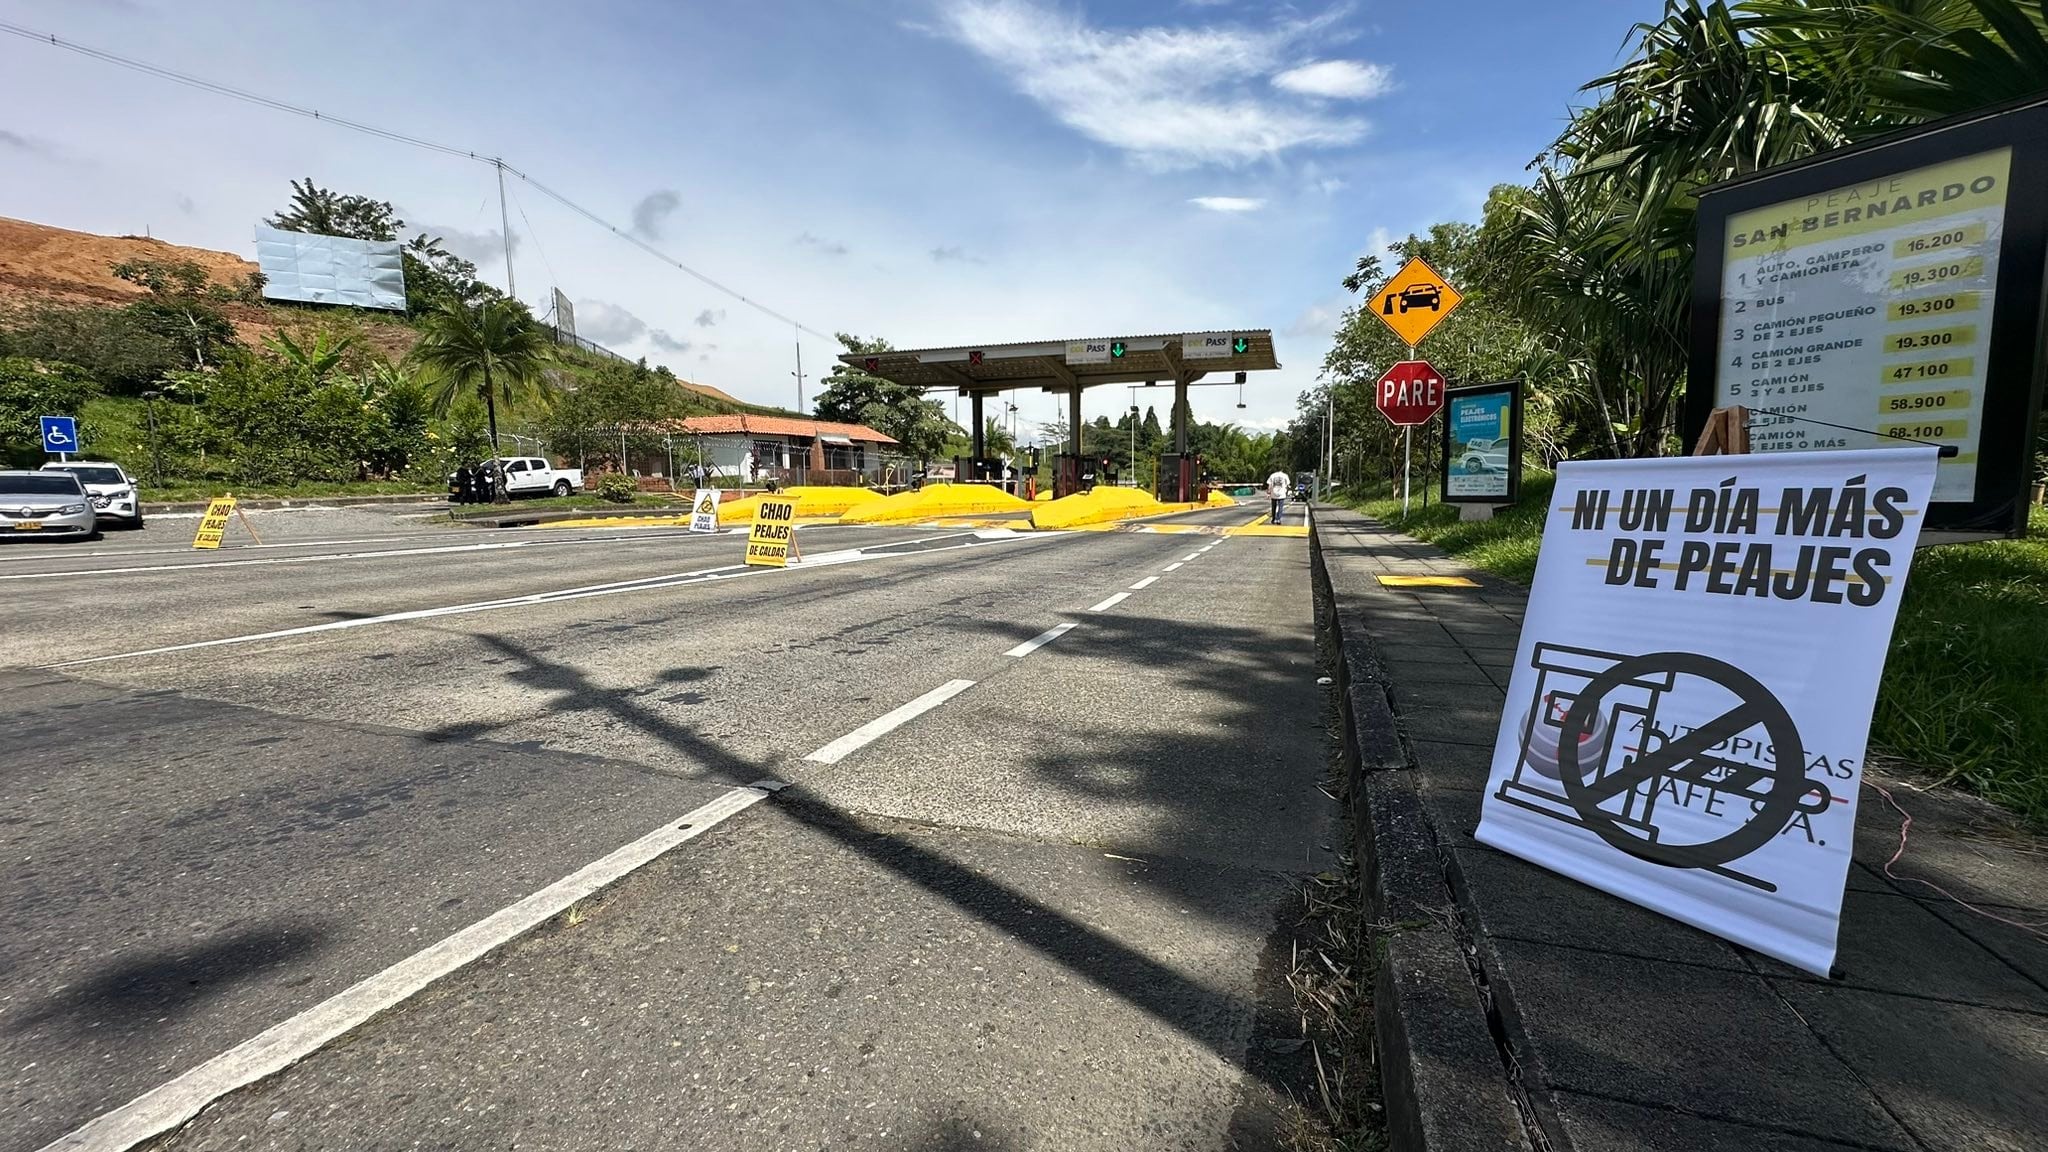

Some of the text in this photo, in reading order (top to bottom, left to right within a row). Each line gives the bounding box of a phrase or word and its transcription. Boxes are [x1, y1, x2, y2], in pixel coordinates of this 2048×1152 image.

[1807, 179, 1902, 212] PEAJE
[1733, 176, 1995, 248] SAN BERNARDO
[1907, 231, 1964, 252] 16.200
[1806, 243, 1885, 265] CAMPERO
[1738, 273, 1746, 286] 1
[1756, 260, 1860, 286] Y CAMIONETA
[1903, 265, 1960, 284] 19.300
[1734, 301, 1746, 314] 2
[1756, 296, 1785, 308] BUS
[1898, 298, 1954, 316] 19.300
[1754, 306, 1876, 332] CAMIÓN PEQUEÑO
[1733, 329, 1744, 340] 3
[1753, 325, 1823, 342] DE 2 EJES
[1205, 337, 1226, 347] PASS
[1896, 333, 1952, 349] 19.300
[1086, 344, 1106, 353] PASS
[1752, 339, 1863, 360] CAMIÓN GRANDE
[1731, 357, 1743, 368] 4
[1752, 354, 1821, 370] DE 2 EJES
[1751, 374, 1809, 387] CAMIÓN
[1383, 379, 1437, 407] PARE
[1730, 384, 1742, 396] 5
[1750, 383, 1825, 398] 3 Y 4 EJES
[1750, 403, 1807, 415] CAMIÓN
[1890, 396, 1945, 410] 58.900
[1461, 407, 1485, 416] PEAJES
[1762, 416, 1795, 425] EJES
[1750, 430, 1805, 441] CAMIÓN
[1889, 426, 1944, 439] 68.100
[1761, 442, 1793, 451] EJES
[1798, 441, 1808, 449] O
[1814, 437, 1846, 448] MÁS
[211, 504, 231, 516] CHAO
[760, 503, 792, 521] CHAO
[1571, 474, 1909, 540] NI UN DÍA MÁS
[204, 519, 226, 530] PEAJES
[697, 515, 710, 523] CHAO
[754, 524, 789, 539] PEAJES
[749, 545, 785, 557] DE CALDAS
[1604, 538, 1891, 607] DE PEAJES
[1629, 717, 1855, 780] AUTPISAS
